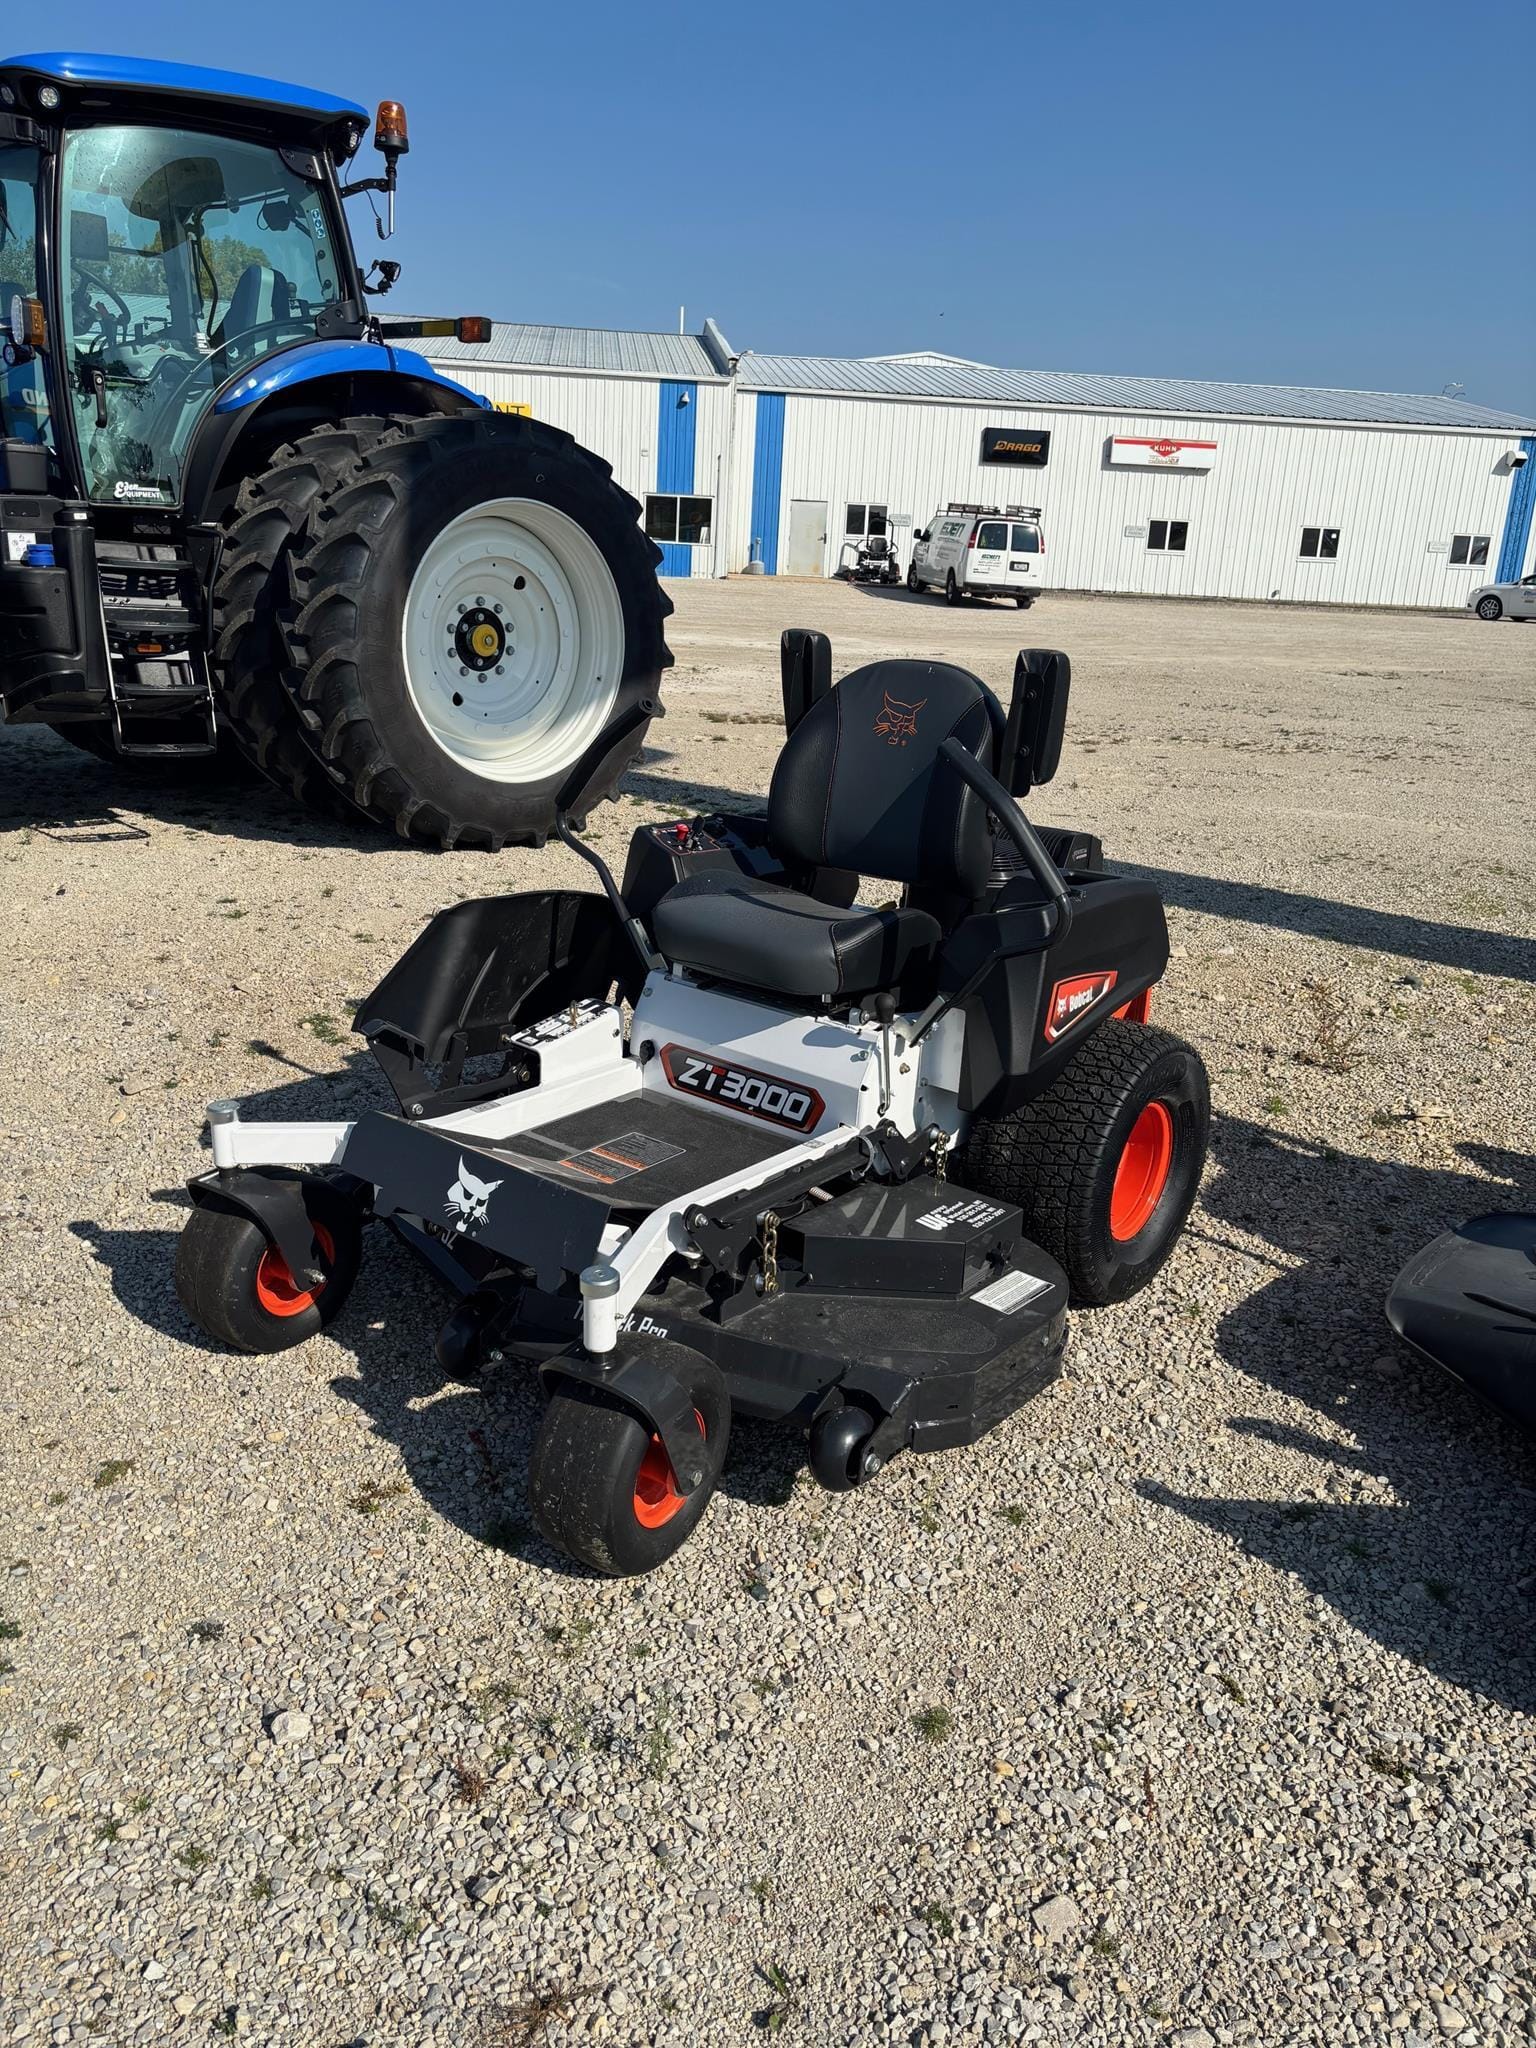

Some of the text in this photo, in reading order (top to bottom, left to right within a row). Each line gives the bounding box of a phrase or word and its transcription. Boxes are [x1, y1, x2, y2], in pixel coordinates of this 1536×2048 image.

[994, 440, 1041, 452] DRAGO
[678, 1057, 811, 1122] ZT3000
[638, 1315, 669, 1339] Pro
